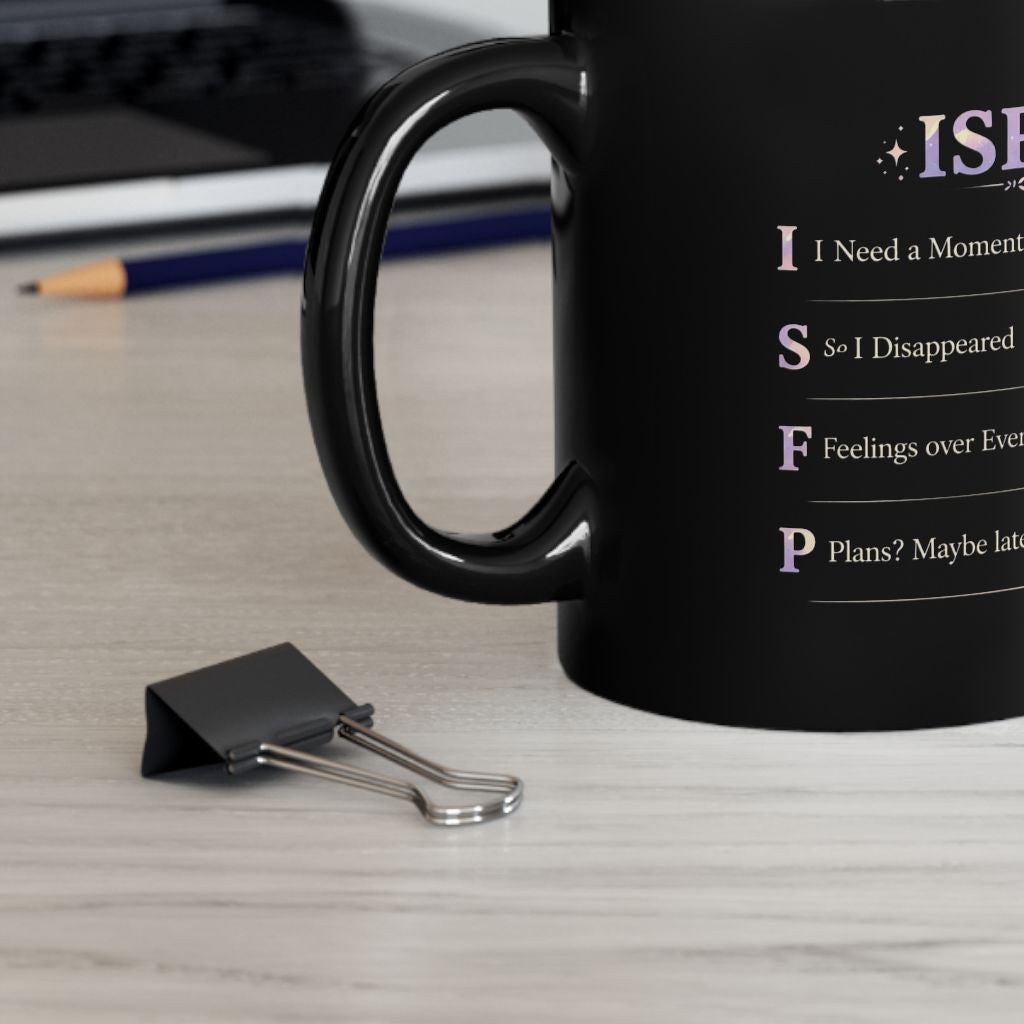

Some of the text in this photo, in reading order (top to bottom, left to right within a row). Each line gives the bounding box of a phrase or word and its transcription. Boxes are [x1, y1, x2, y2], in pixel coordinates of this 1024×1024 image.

[776, 225, 1024, 271] I I Need a Moment
[778, 323, 1015, 370] S So I Disappeared
[778, 425, 812, 471] F
[823, 437, 918, 465] Feelings
[925, 437, 974, 457] over
[779, 527, 816, 573] P
[828, 538, 904, 563] Plans?
[912, 535, 988, 565] Maybe
